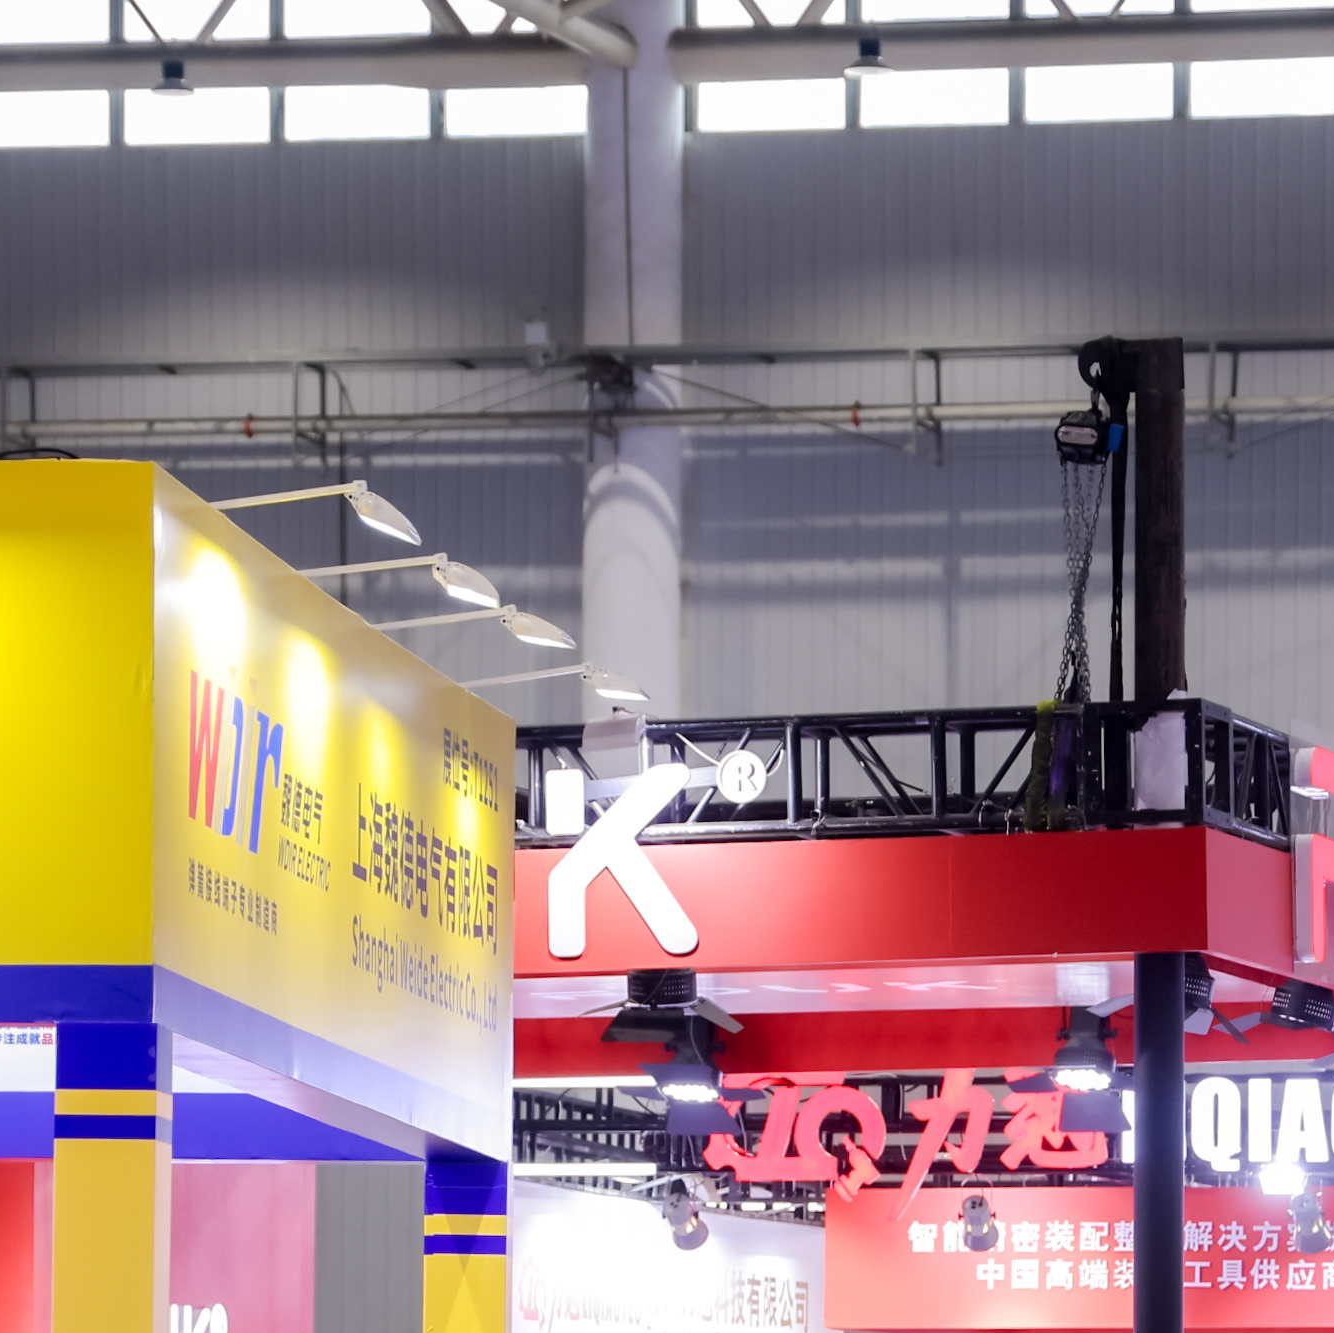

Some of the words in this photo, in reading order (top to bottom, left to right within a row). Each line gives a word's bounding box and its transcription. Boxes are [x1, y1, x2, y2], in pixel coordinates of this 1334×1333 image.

[279, 773, 324, 845] 魏德电气
[187, 857, 278, 936] 弹簧接线端子专业制造商
[278, 834, 297, 878] WDIR
[297, 845, 332, 893] ELECTRIC
[352, 782, 499, 956] 上海魏德电气有限公司
[352, 914, 398, 994] Shanghai
[399, 937, 429, 1001] Weide
[430, 953, 464, 1018] Electric
[483, 981, 498, 1033] Ltd
